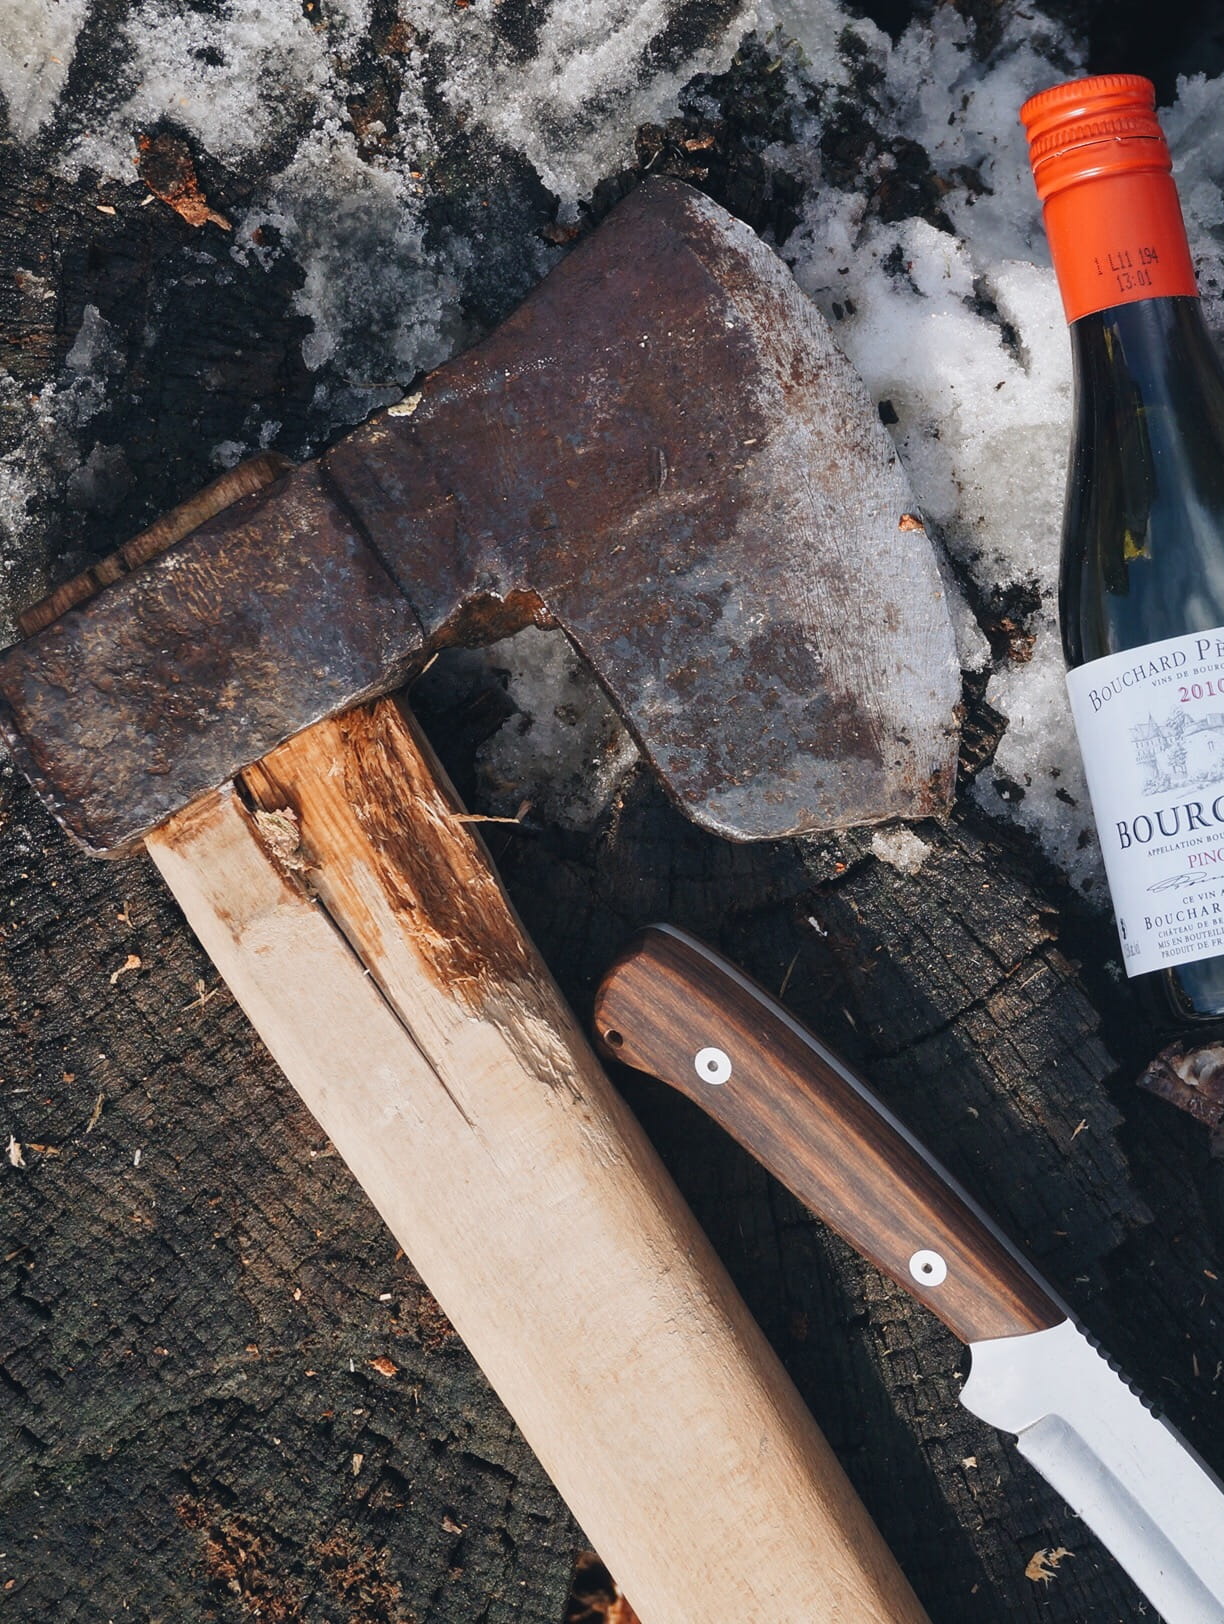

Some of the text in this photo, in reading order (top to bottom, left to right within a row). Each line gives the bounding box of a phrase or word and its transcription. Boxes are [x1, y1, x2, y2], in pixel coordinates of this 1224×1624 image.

[1139, 247, 1159, 265] 194
[1117, 269, 1152, 292] 13:01
[1088, 650, 1187, 713] BOUCHARD
[1151, 676, 1173, 687] VINS
[1176, 671, 1190, 680] DE
[1147, 837, 1204, 857] APPELLATION
[1182, 896, 1194, 905] CE
[1197, 890, 1216, 900] VIN
[1197, 920, 1208, 929] DE
[1158, 940, 1170, 950] MIS
[1171, 934, 1183, 945] EN
[1161, 944, 1195, 959] PRODUIT
[1197, 940, 1209, 950] DE
